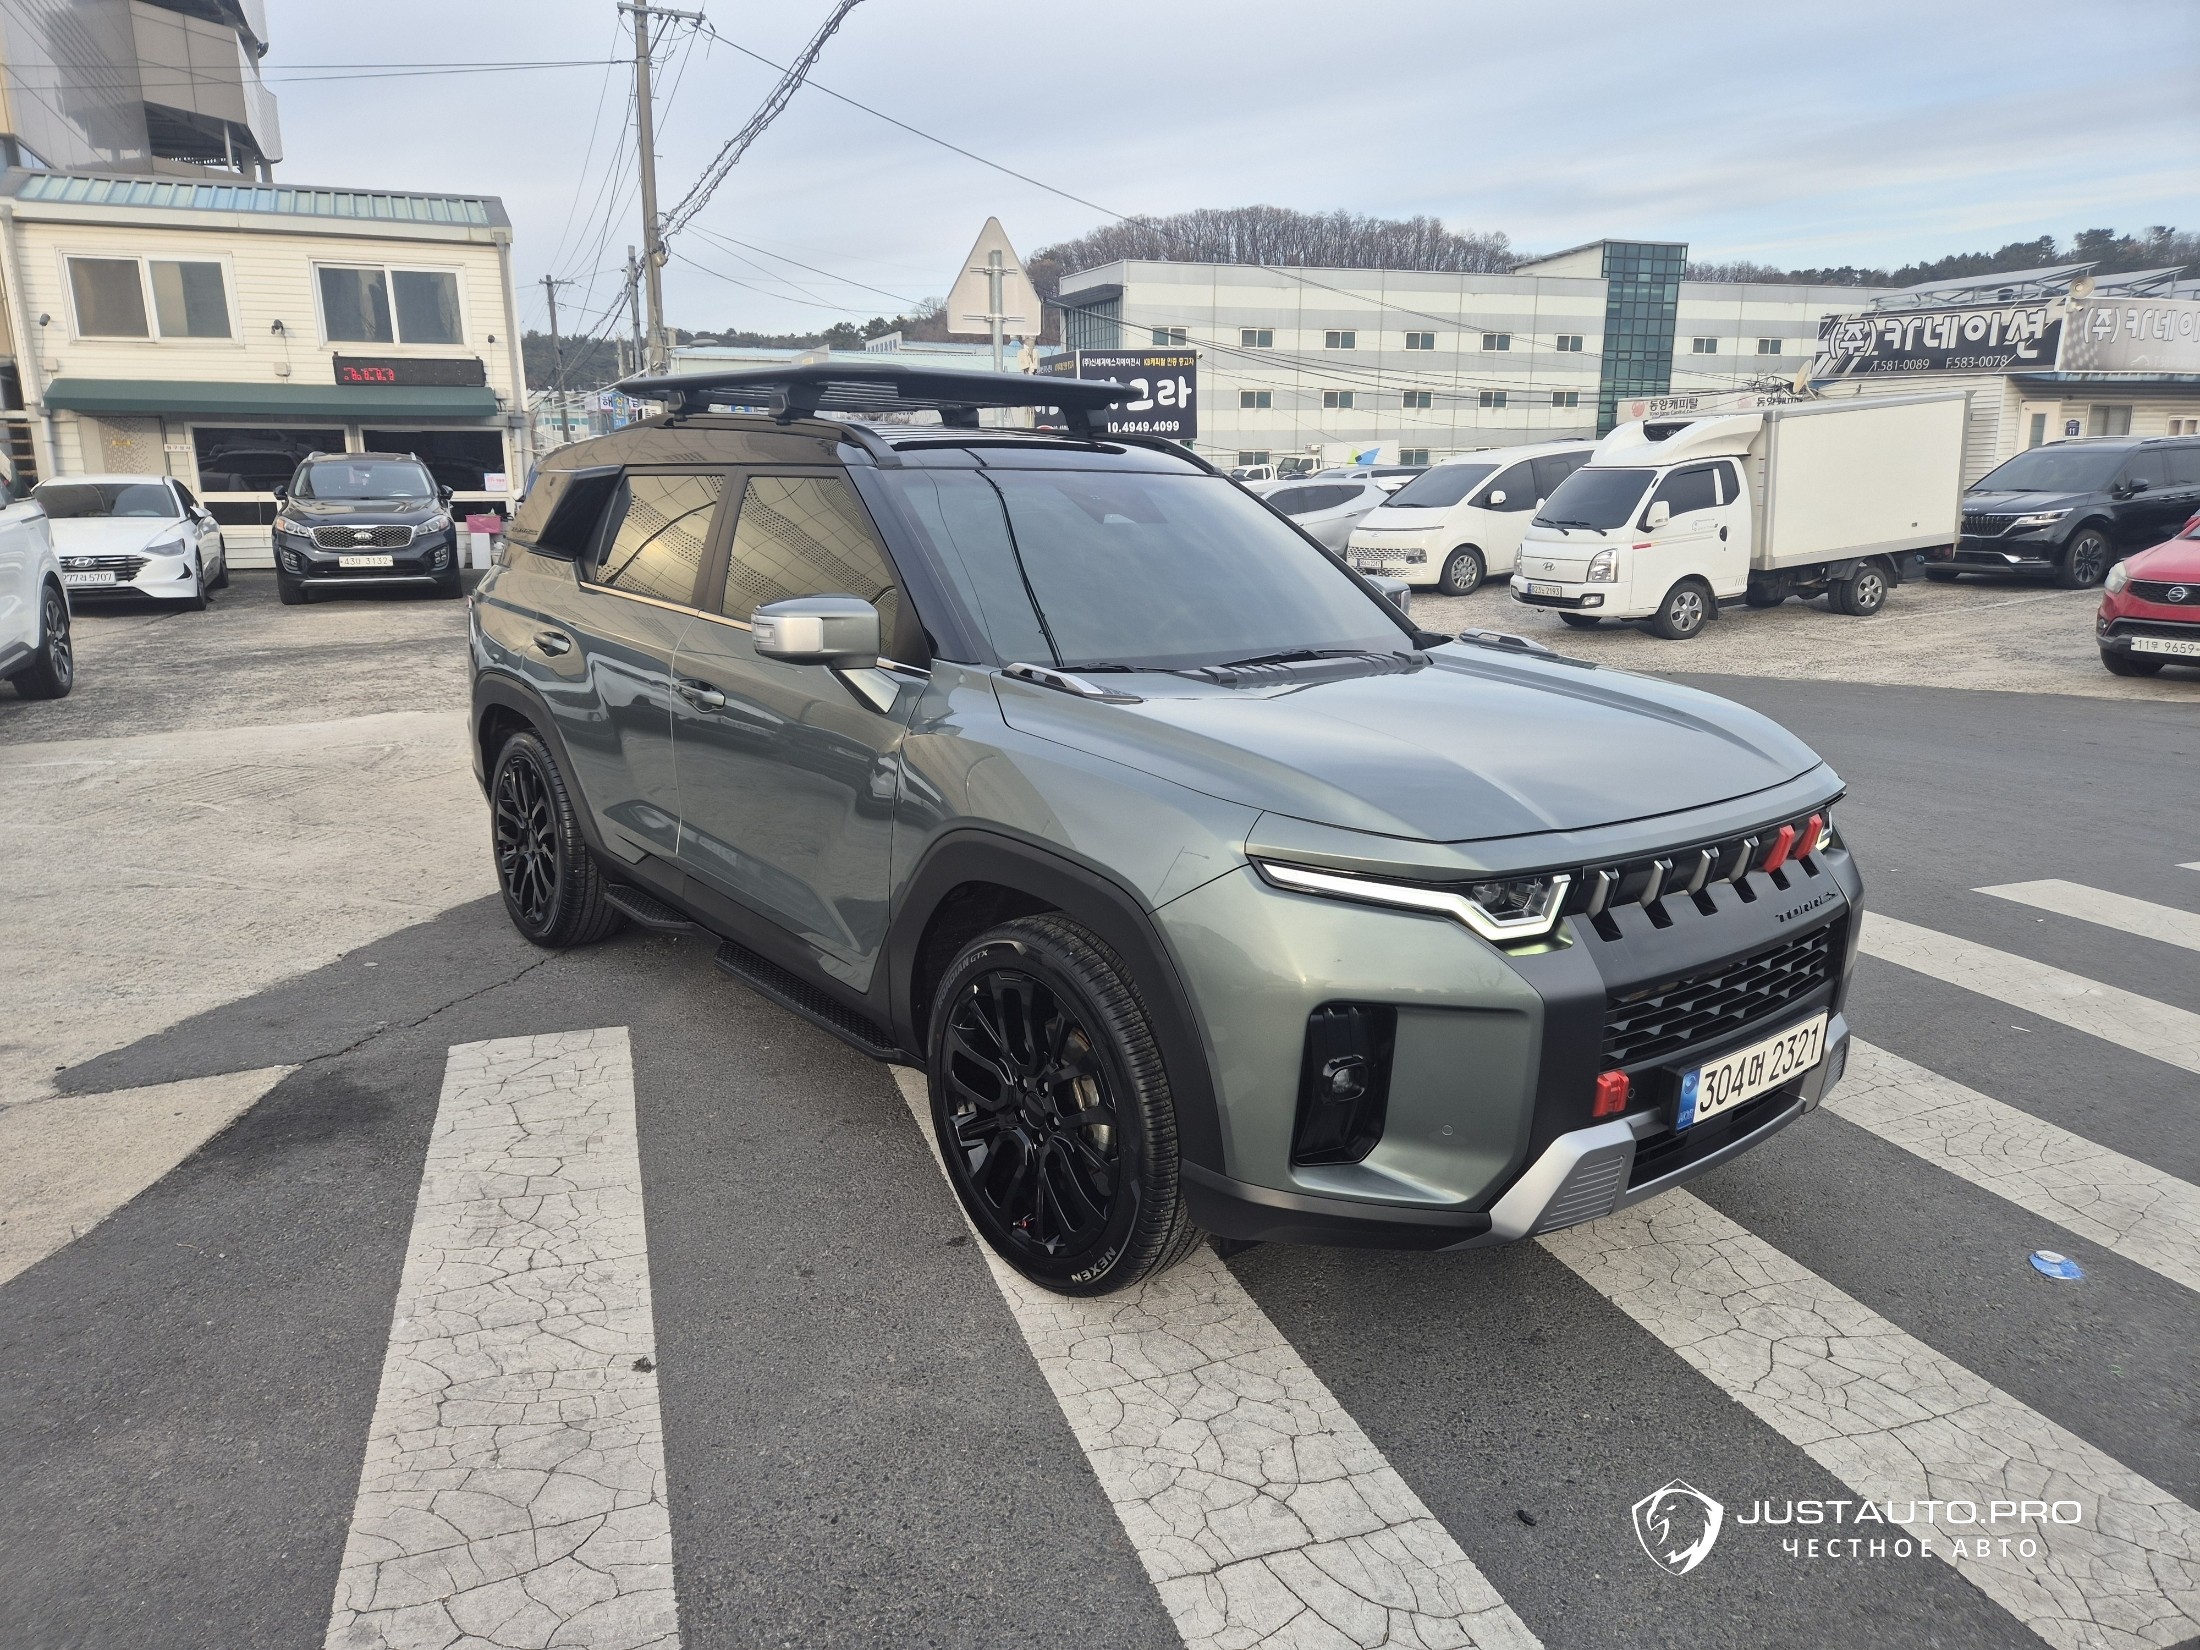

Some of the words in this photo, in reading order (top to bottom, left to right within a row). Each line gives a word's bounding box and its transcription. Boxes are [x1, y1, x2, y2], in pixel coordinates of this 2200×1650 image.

[1873, 358, 1930, 372] T.581-0089
[1946, 355, 2008, 369] F.583-0078
[1650, 398, 1698, 411] 동양캐피탈
[89, 573, 111, 582] 5707
[2164, 641, 2195, 654] 9659
[1699, 1051, 1766, 1113] 304머
[1768, 1022, 1820, 1082] 2321
[1071, 1246, 1117, 1283] NEXEN
